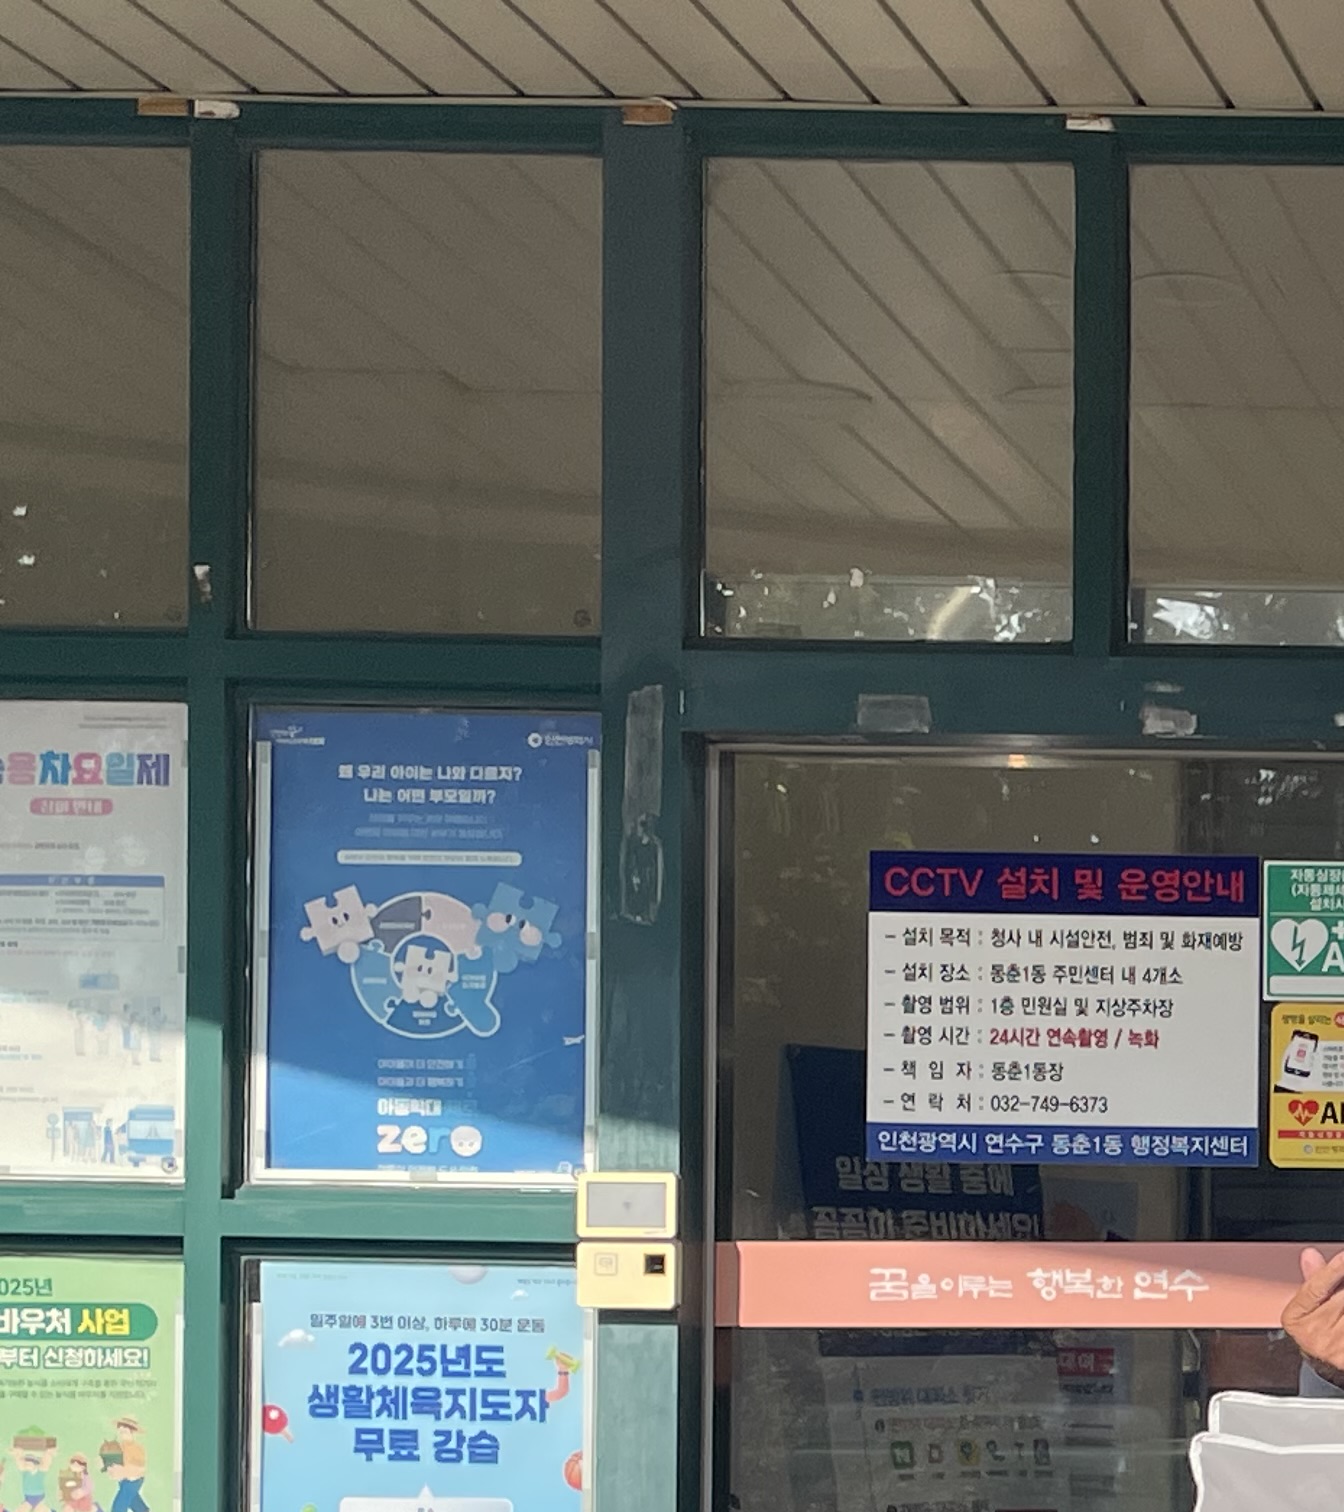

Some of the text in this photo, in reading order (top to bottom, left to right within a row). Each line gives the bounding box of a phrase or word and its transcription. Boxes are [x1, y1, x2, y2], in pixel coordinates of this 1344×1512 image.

[358, 764, 385, 781] 우리
[391, 765, 433, 781] 아이는
[437, 765, 466, 782] 나와
[363, 788, 497, 805] 나는 어떤 부모일까?
[884, 866, 1244, 903] CCTV 설치 및 운영안내
[902, 927, 1243, 951] 설치 목적 청사 내 시설안전, 범죄 및 화재예방
[902, 962, 1184, 985] 설치 장소 동춘1동 주민센터 내 4개소
[901, 994, 1174, 1018] 촬영 범위 1층 민원실 및 지상주차장
[901, 1025, 932, 1045] 촬영
[939, 1026, 970, 1046] 시간
[990, 1027, 1040, 1047] 24시간
[1046, 1027, 1108, 1048] 연속촬영
[1128, 1028, 1160, 1049] 녹화
[991, 1060, 1064, 1082] 동춘1동장
[990, 1094, 1108, 1113] 032-749-6373
[878, 1131, 1249, 1157] 인천광역시 연수구 동춘1동 행정복지센터
[835, 1155, 889, 1192] 일상
[1026, 1267, 1210, 1303] 행복한 연수
[77, 1307, 130, 1336] 사업
[309, 1313, 546, 1334] 일주일에 3번 이상, 하루에 30분 운동
[44, 1347, 150, 1369] 신청하세요!
[347, 1341, 507, 1379] 2025년도
[307, 1384, 550, 1424] 생활체육지도자
[353, 1428, 500, 1465] 무료 강습
